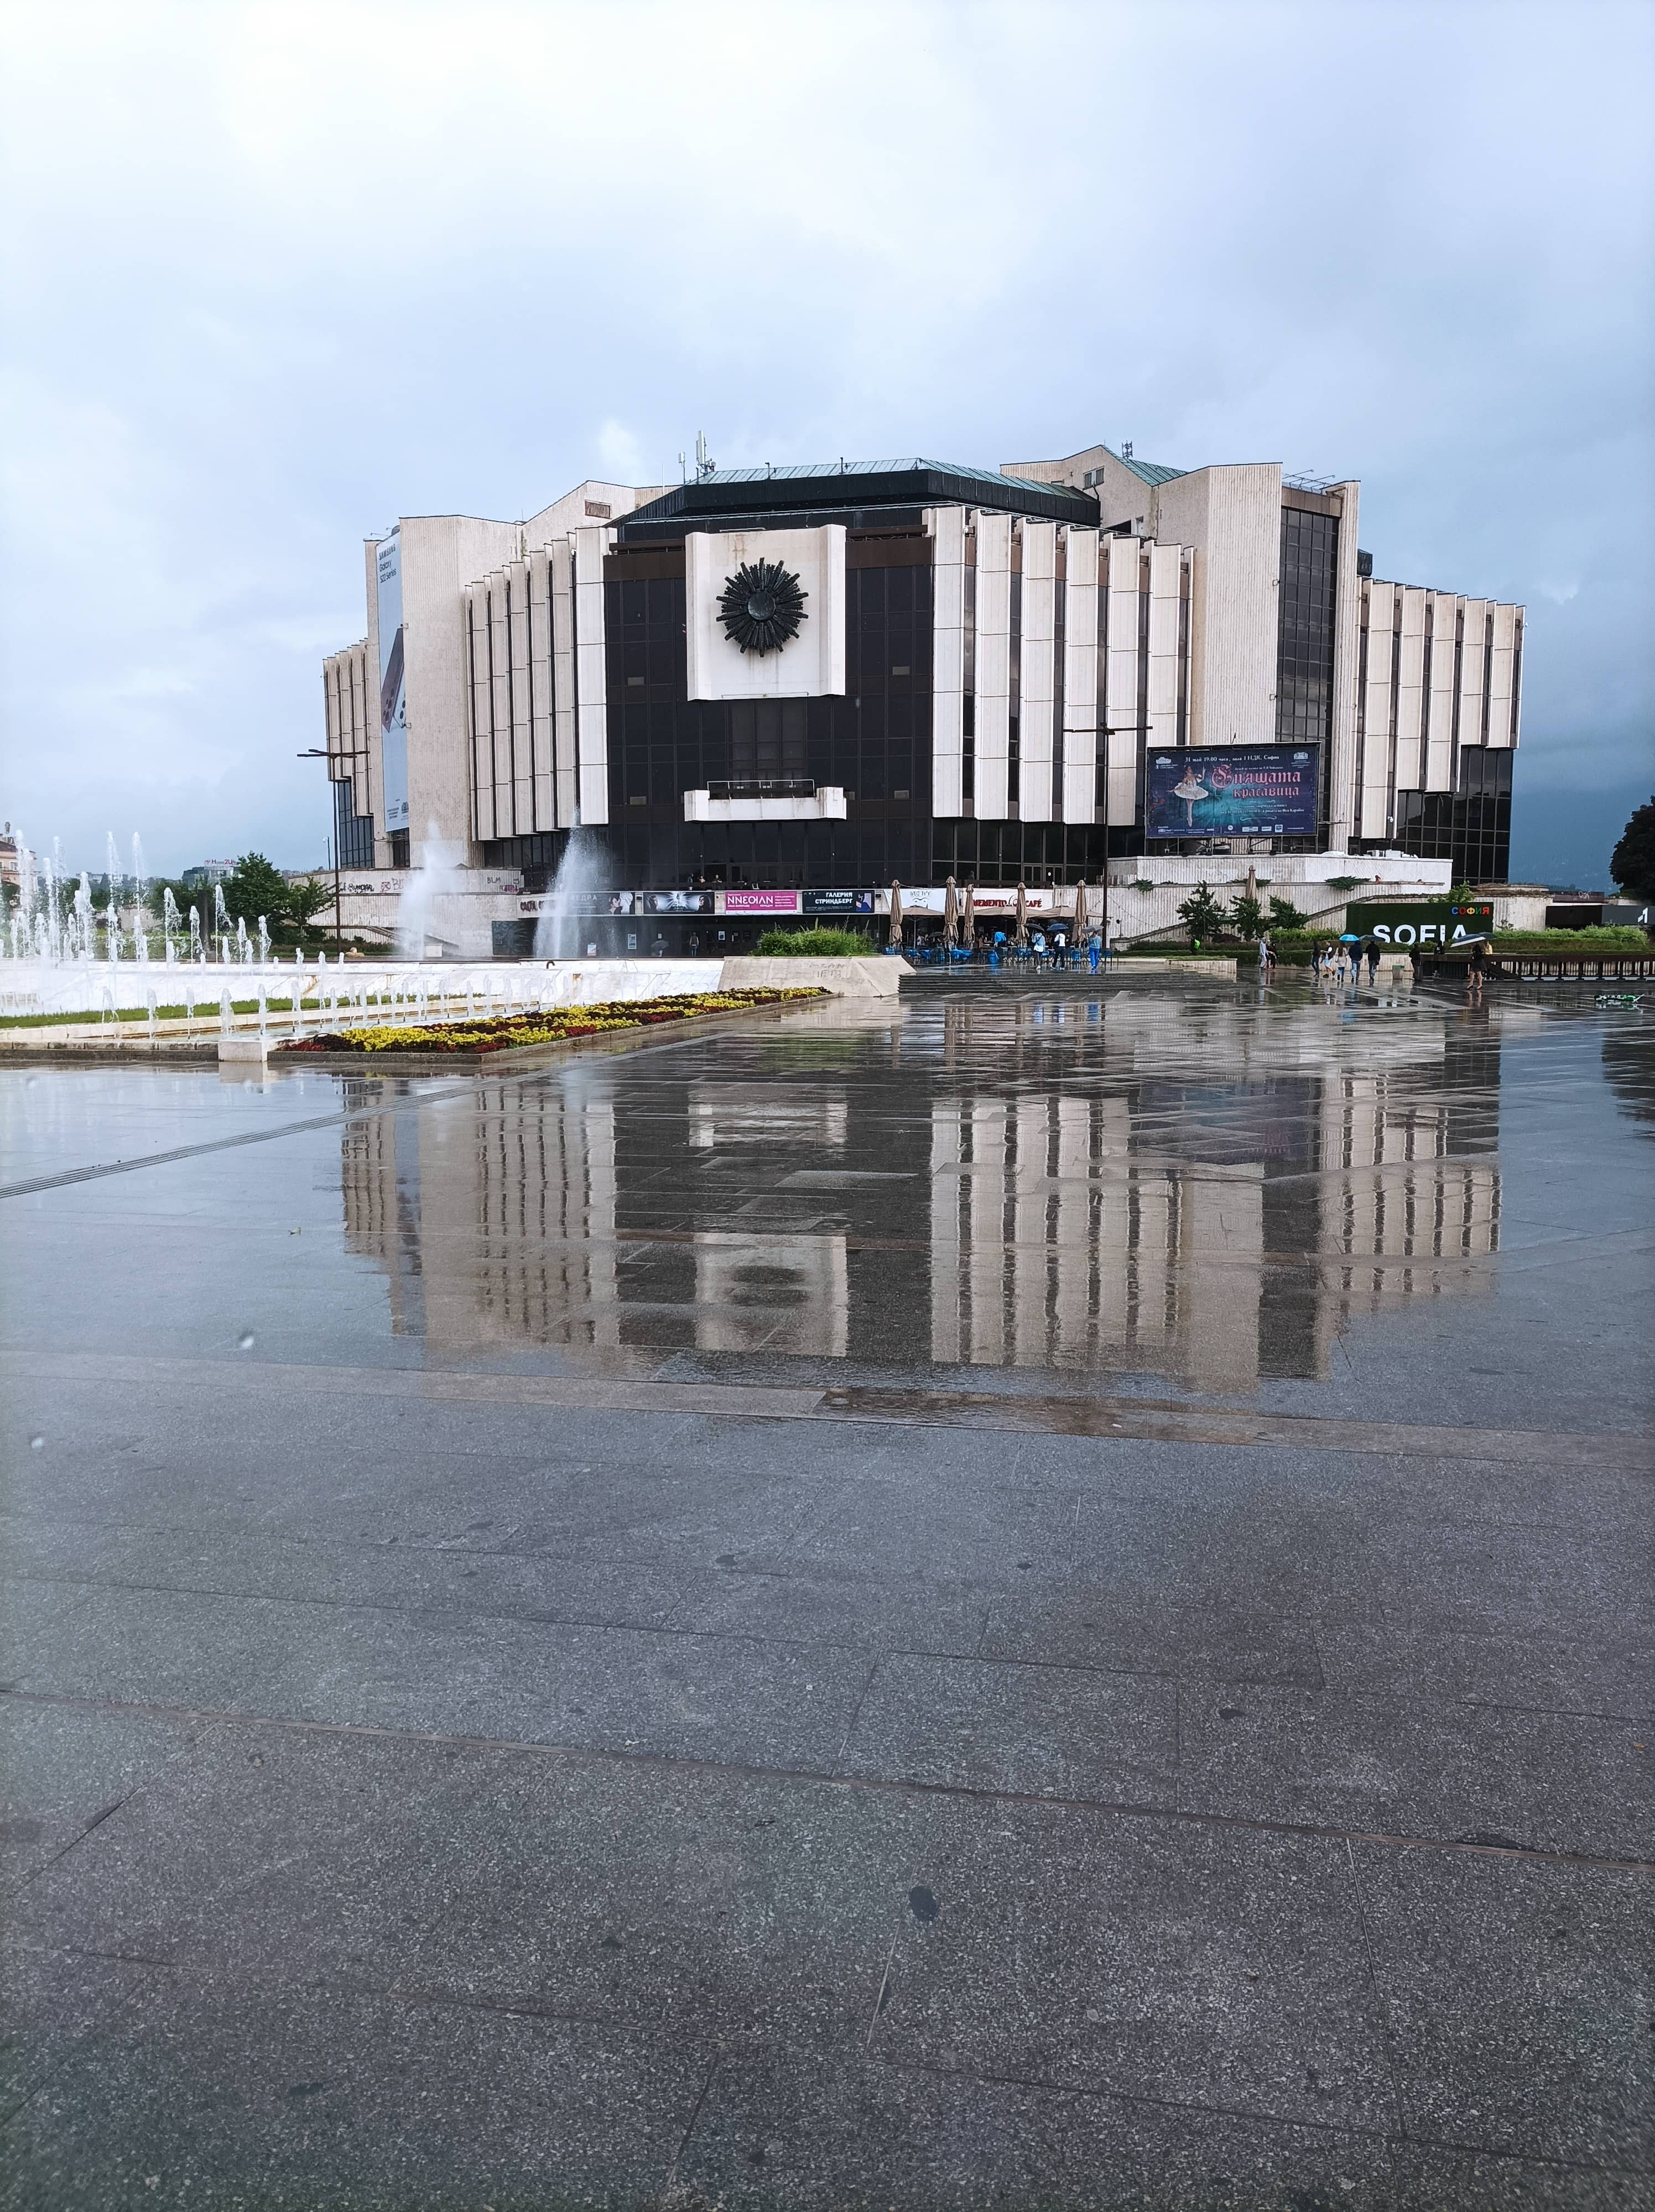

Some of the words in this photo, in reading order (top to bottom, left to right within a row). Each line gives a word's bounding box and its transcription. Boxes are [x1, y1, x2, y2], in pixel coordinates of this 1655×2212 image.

[379, 544, 395, 560] SAMSUNG
[379, 560, 392, 572] Galaxy
[1211, 764, 1301, 789] Спящата
[1234, 787, 1299, 799] красавица
[1451, 907, 1490, 915] СОФИЯ
[1373, 925, 1467, 946] SOFIA
